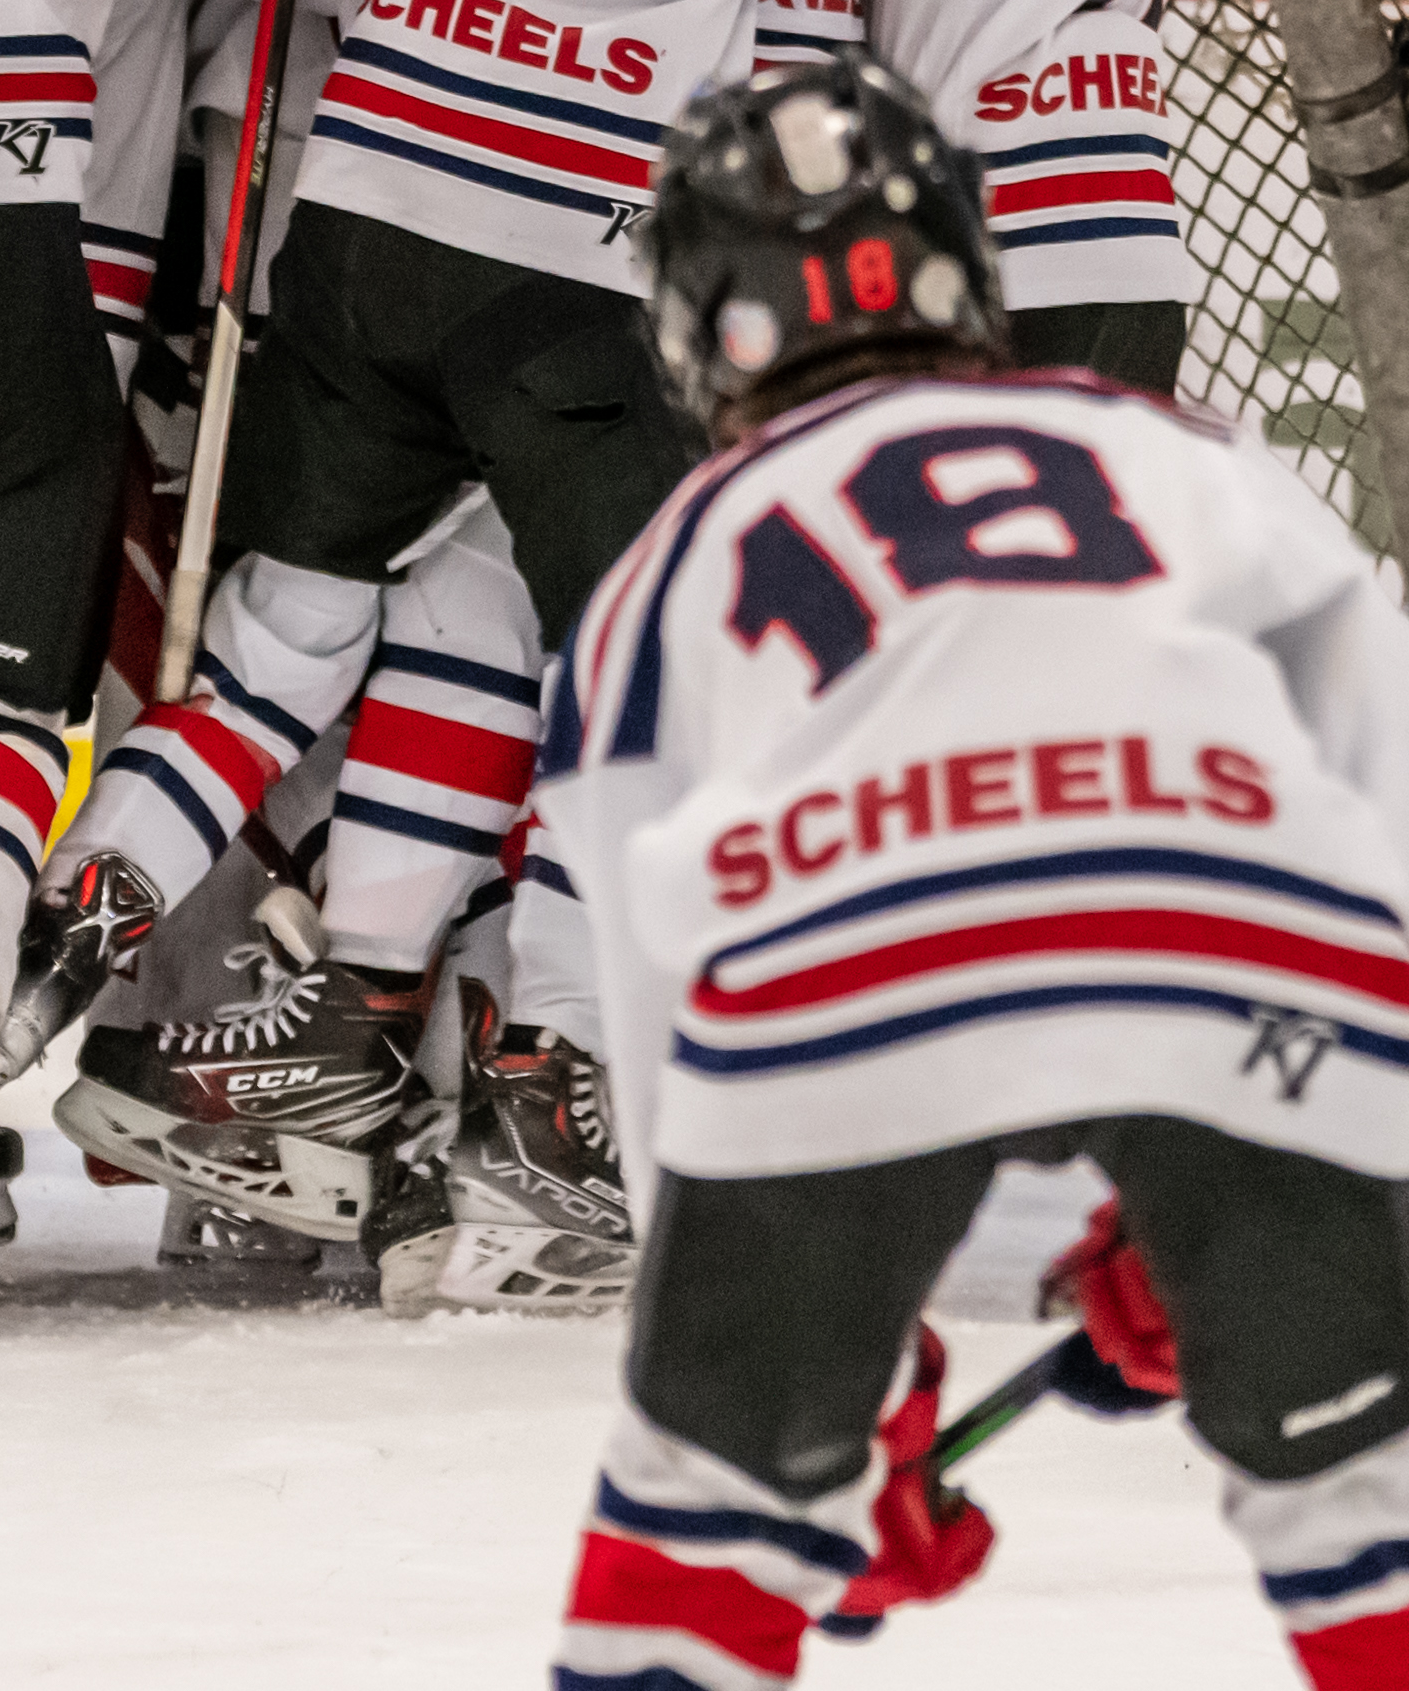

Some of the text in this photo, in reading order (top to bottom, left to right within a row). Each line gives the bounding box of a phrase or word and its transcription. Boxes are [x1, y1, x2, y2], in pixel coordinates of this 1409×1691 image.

[801, 237, 899, 326] 18
[724, 423, 1169, 701] 18
[705, 733, 1277, 910] SCHEELS
[226, 1065, 319, 1093] CCM
[480, 1145, 628, 1235] VAPOR
